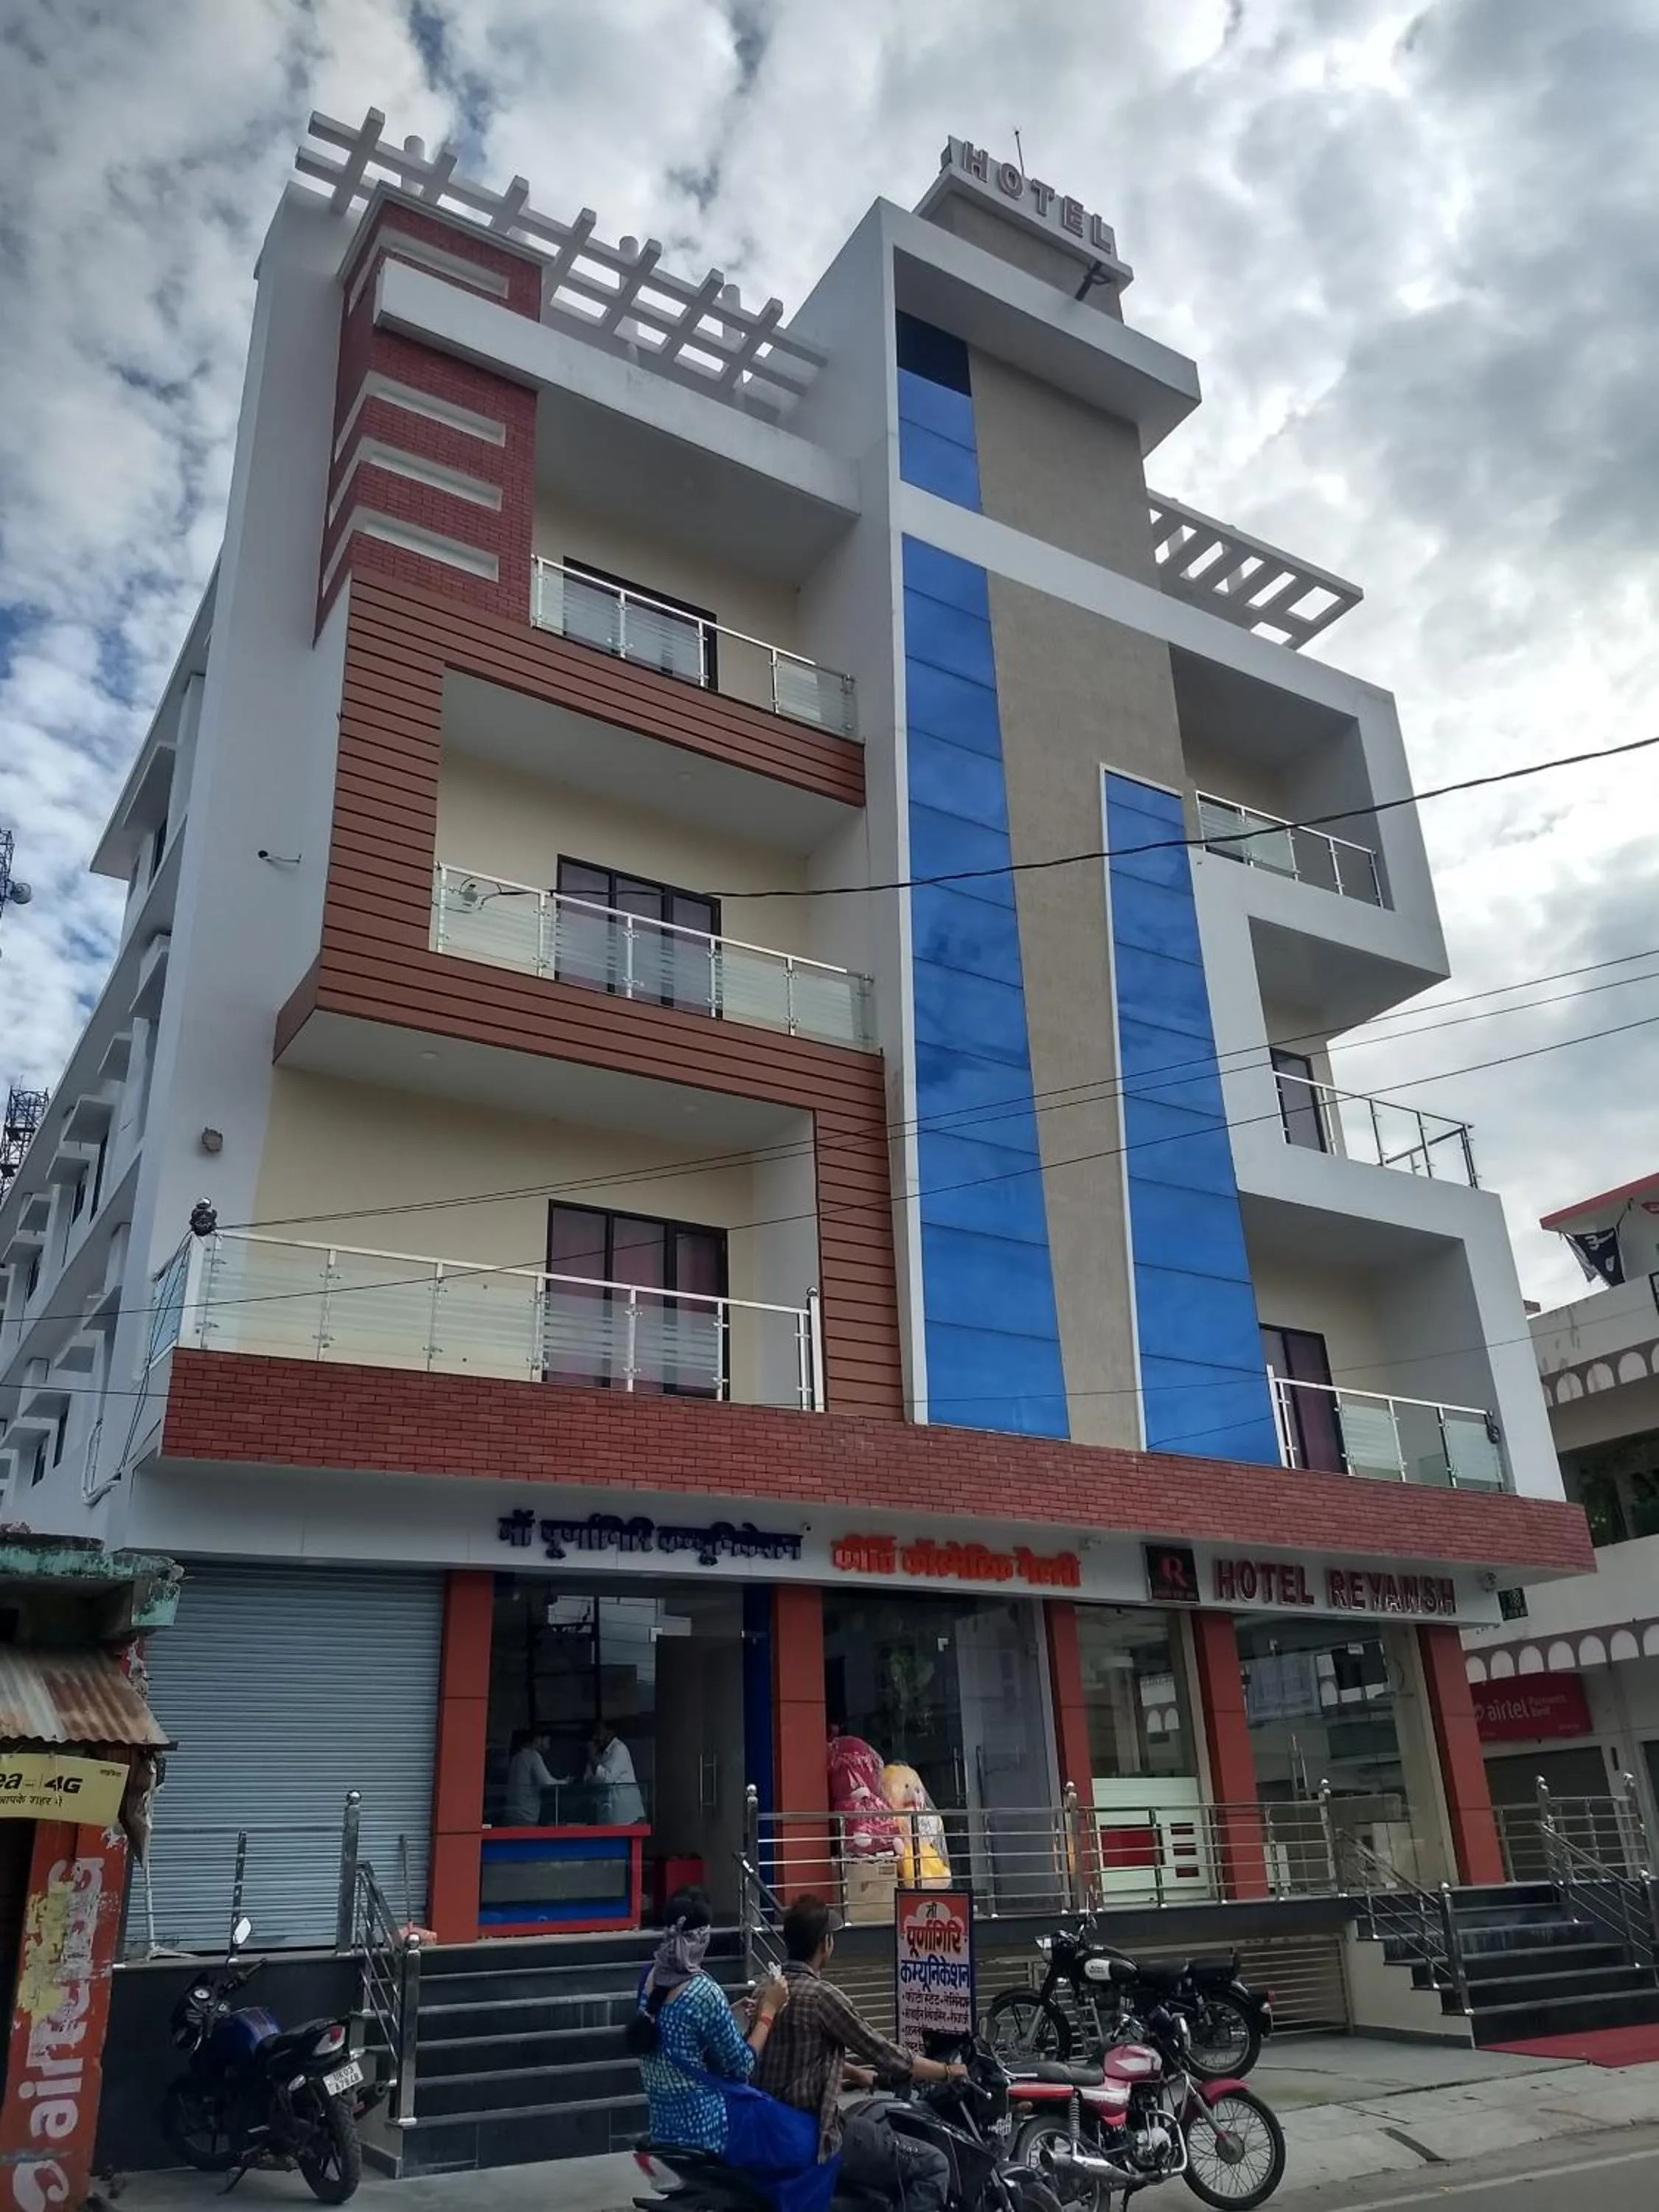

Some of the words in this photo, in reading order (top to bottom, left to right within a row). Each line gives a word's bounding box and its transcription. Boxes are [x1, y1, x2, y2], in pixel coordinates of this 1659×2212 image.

[963, 140, 1111, 254] HOTEL
[1214, 1558, 1315, 1606] HOTEL
[1486, 1697, 1529, 1722] airtel
[44, 1775, 83, 1794] 4G
[906, 1919, 962, 1958] पूर्णागिरि
[900, 1954, 970, 1992] कम्यूनिकेशन
